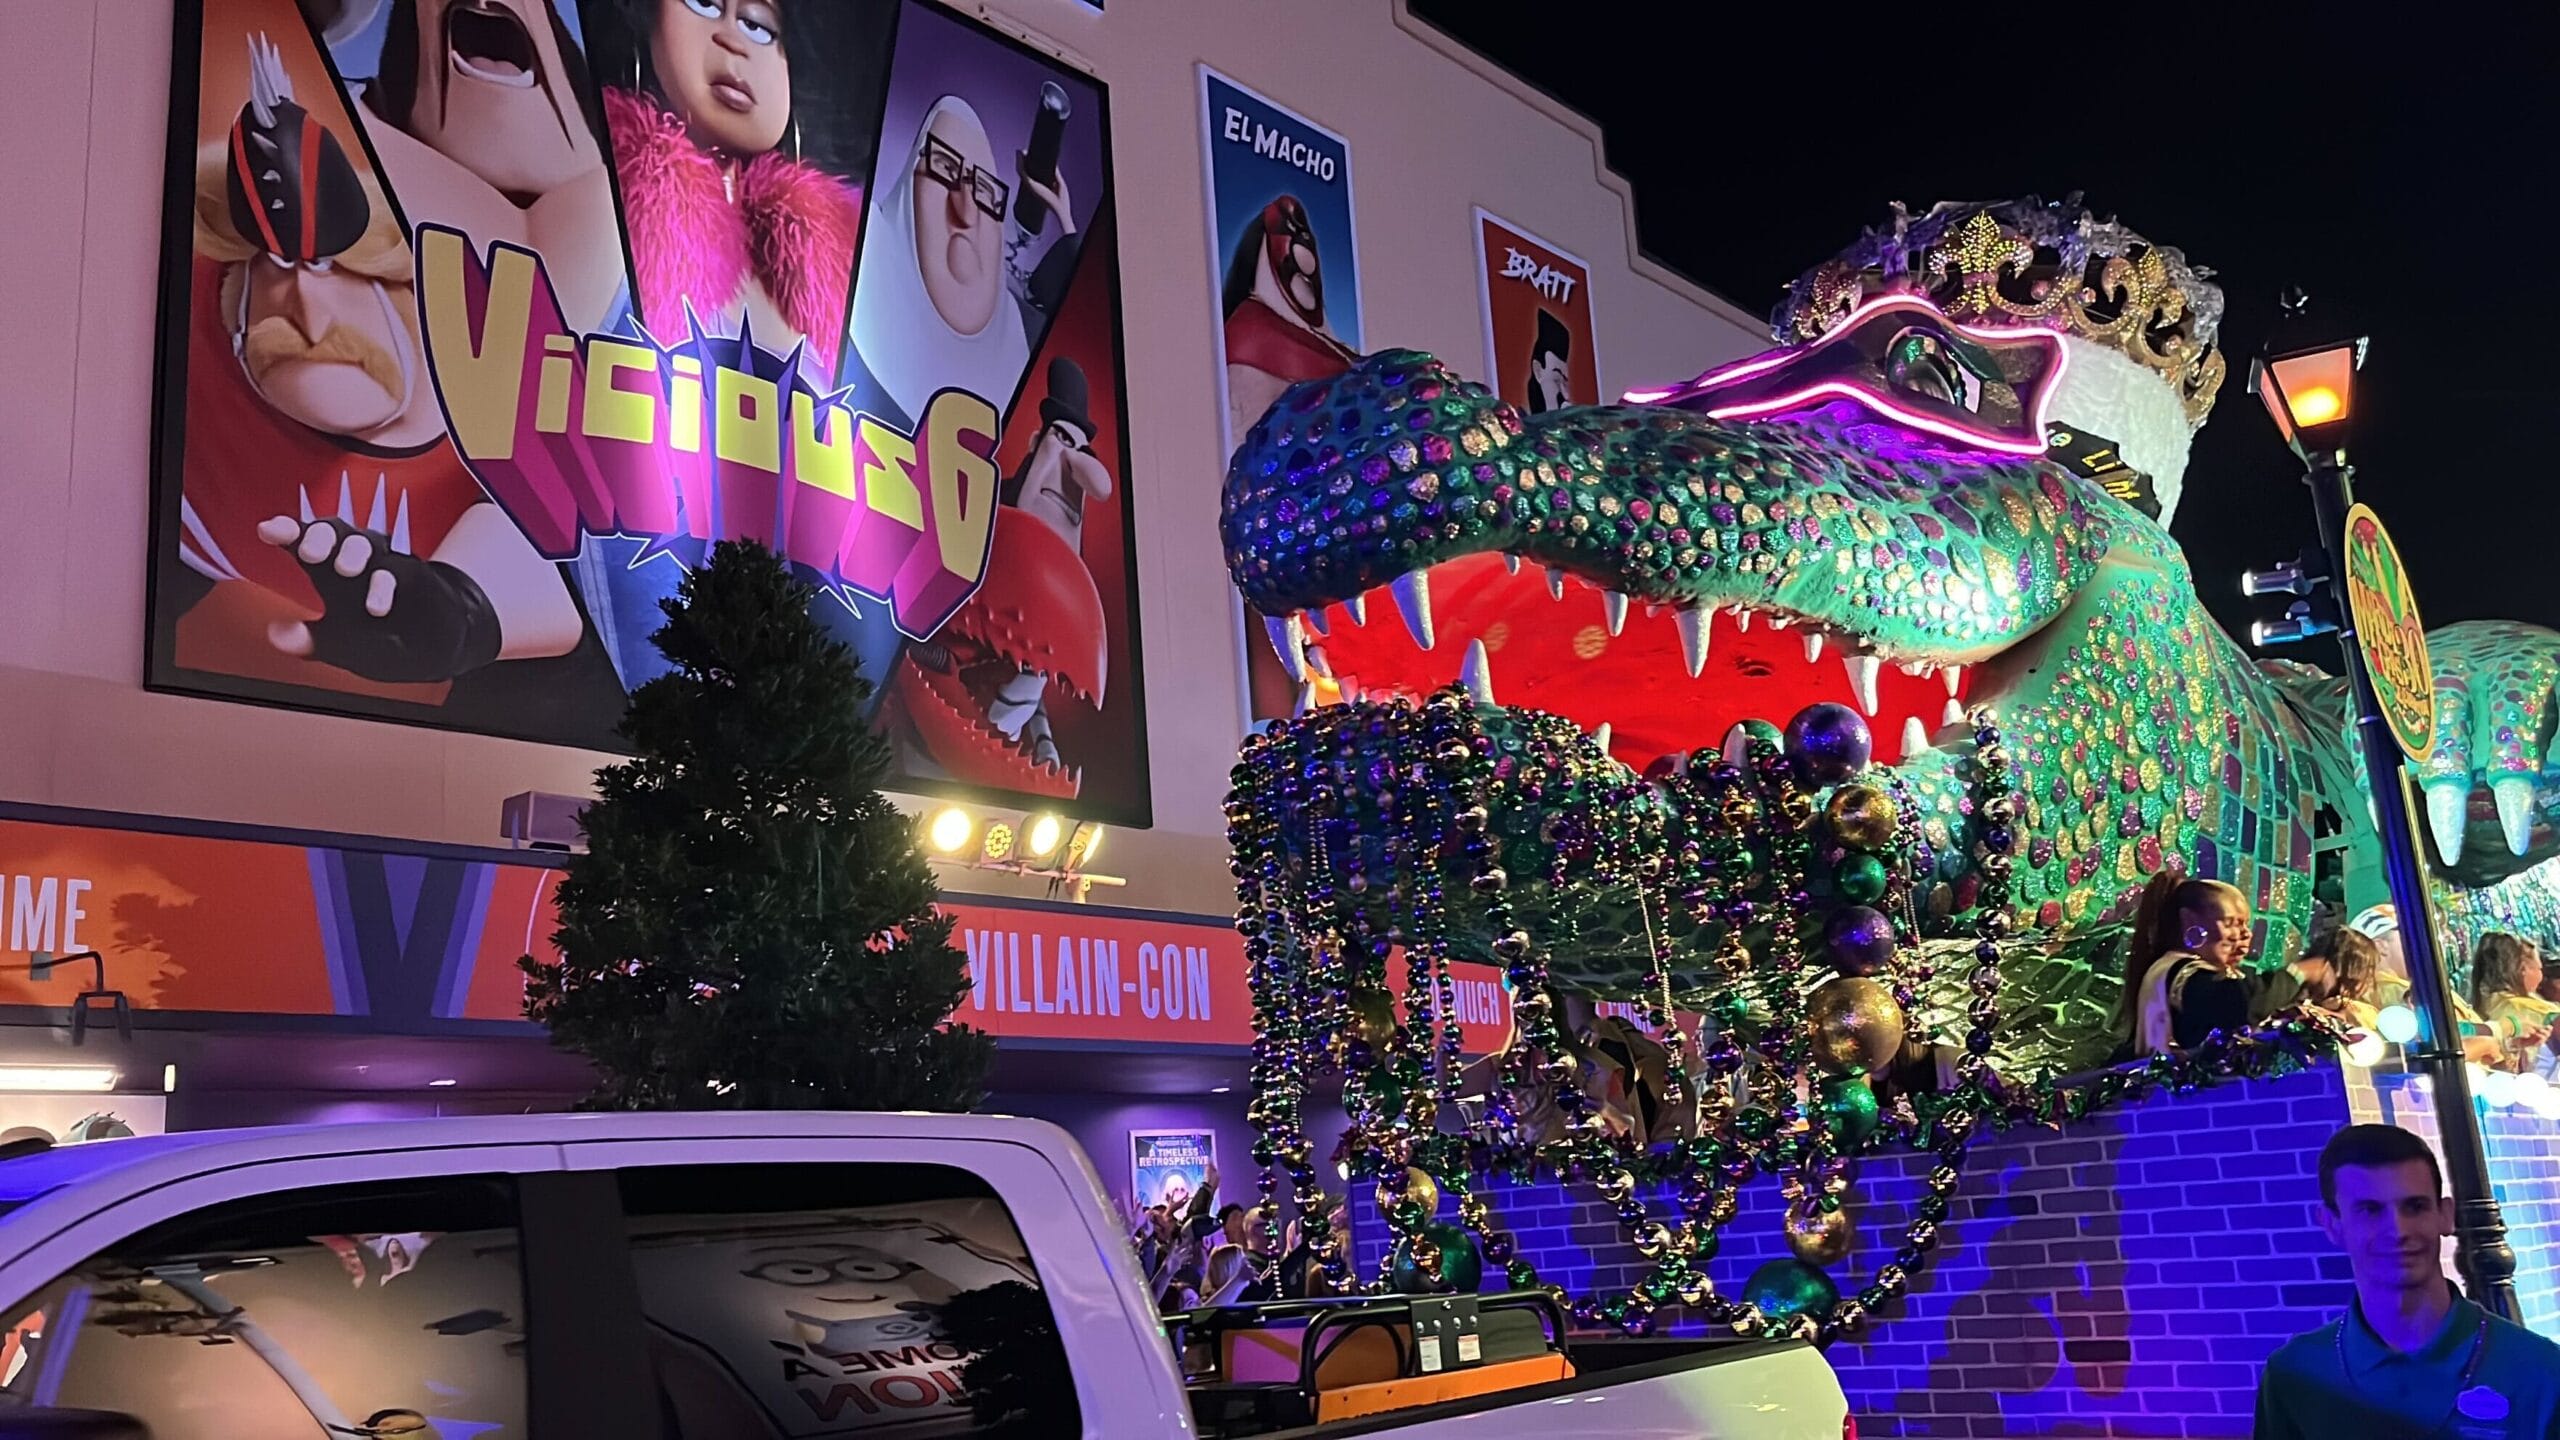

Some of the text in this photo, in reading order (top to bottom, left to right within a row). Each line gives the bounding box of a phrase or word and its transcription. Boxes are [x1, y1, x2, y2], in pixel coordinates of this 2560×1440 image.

[1224, 106, 1335, 181] EL MACHO
[1498, 245, 1577, 304] BRATT
[965, 928, 1211, 1021] VILLAIN-CON
[1450, 979, 1500, 1025] MUCH
[1139, 1155, 1209, 1167] RETROSPECTIVE
[1158, 1147, 1199, 1157] TIMELESS
